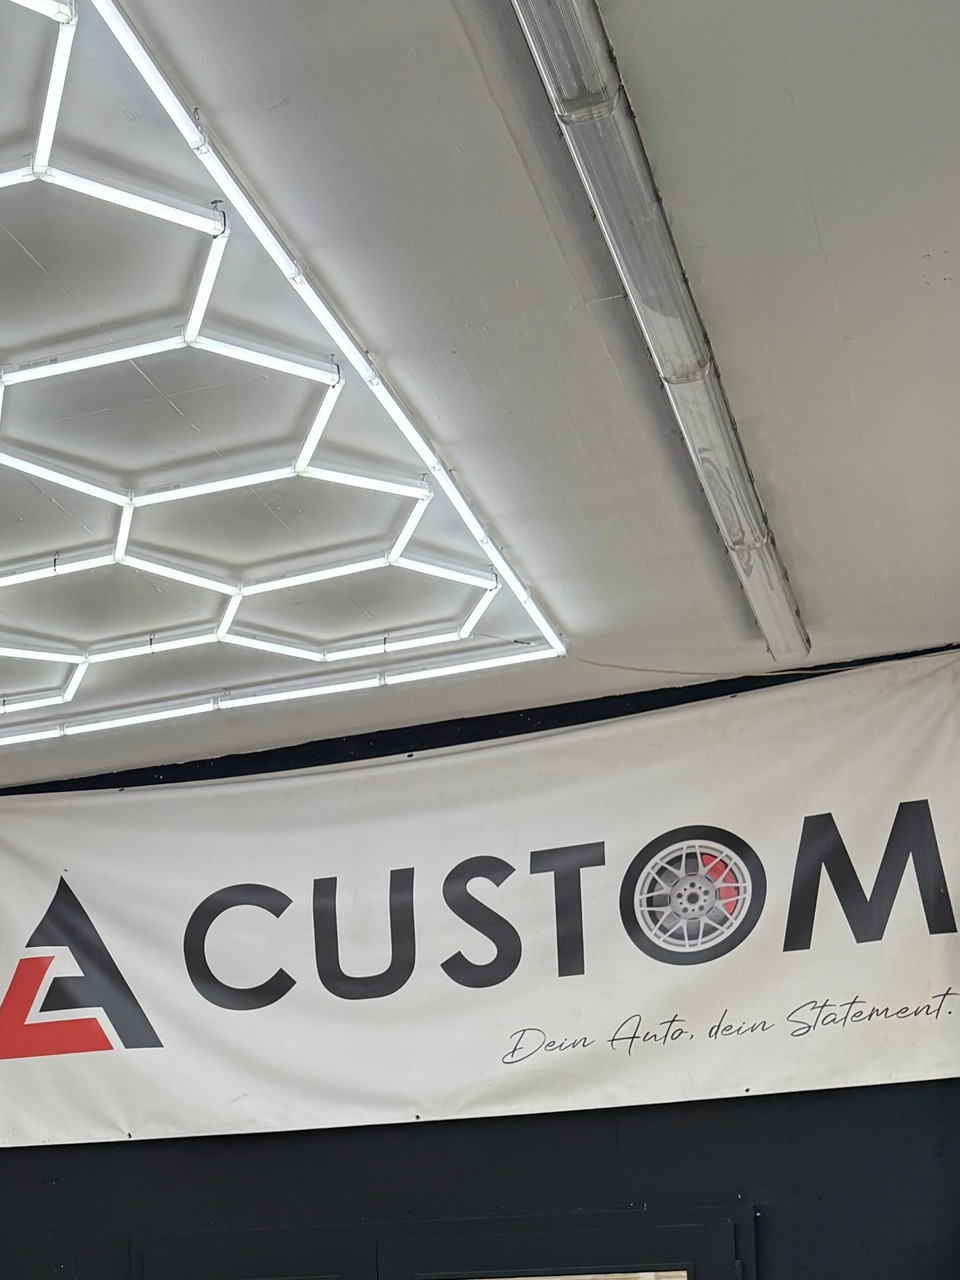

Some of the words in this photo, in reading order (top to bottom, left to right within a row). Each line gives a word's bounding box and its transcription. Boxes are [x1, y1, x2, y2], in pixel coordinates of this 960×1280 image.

[183, 798, 958, 1012] CUSTOM
[501, 1028, 596, 1065] Dein
[607, 1014, 694, 1057] Auto,
[708, 1009, 776, 1040] dein
[786, 986, 959, 1037] Statement.
